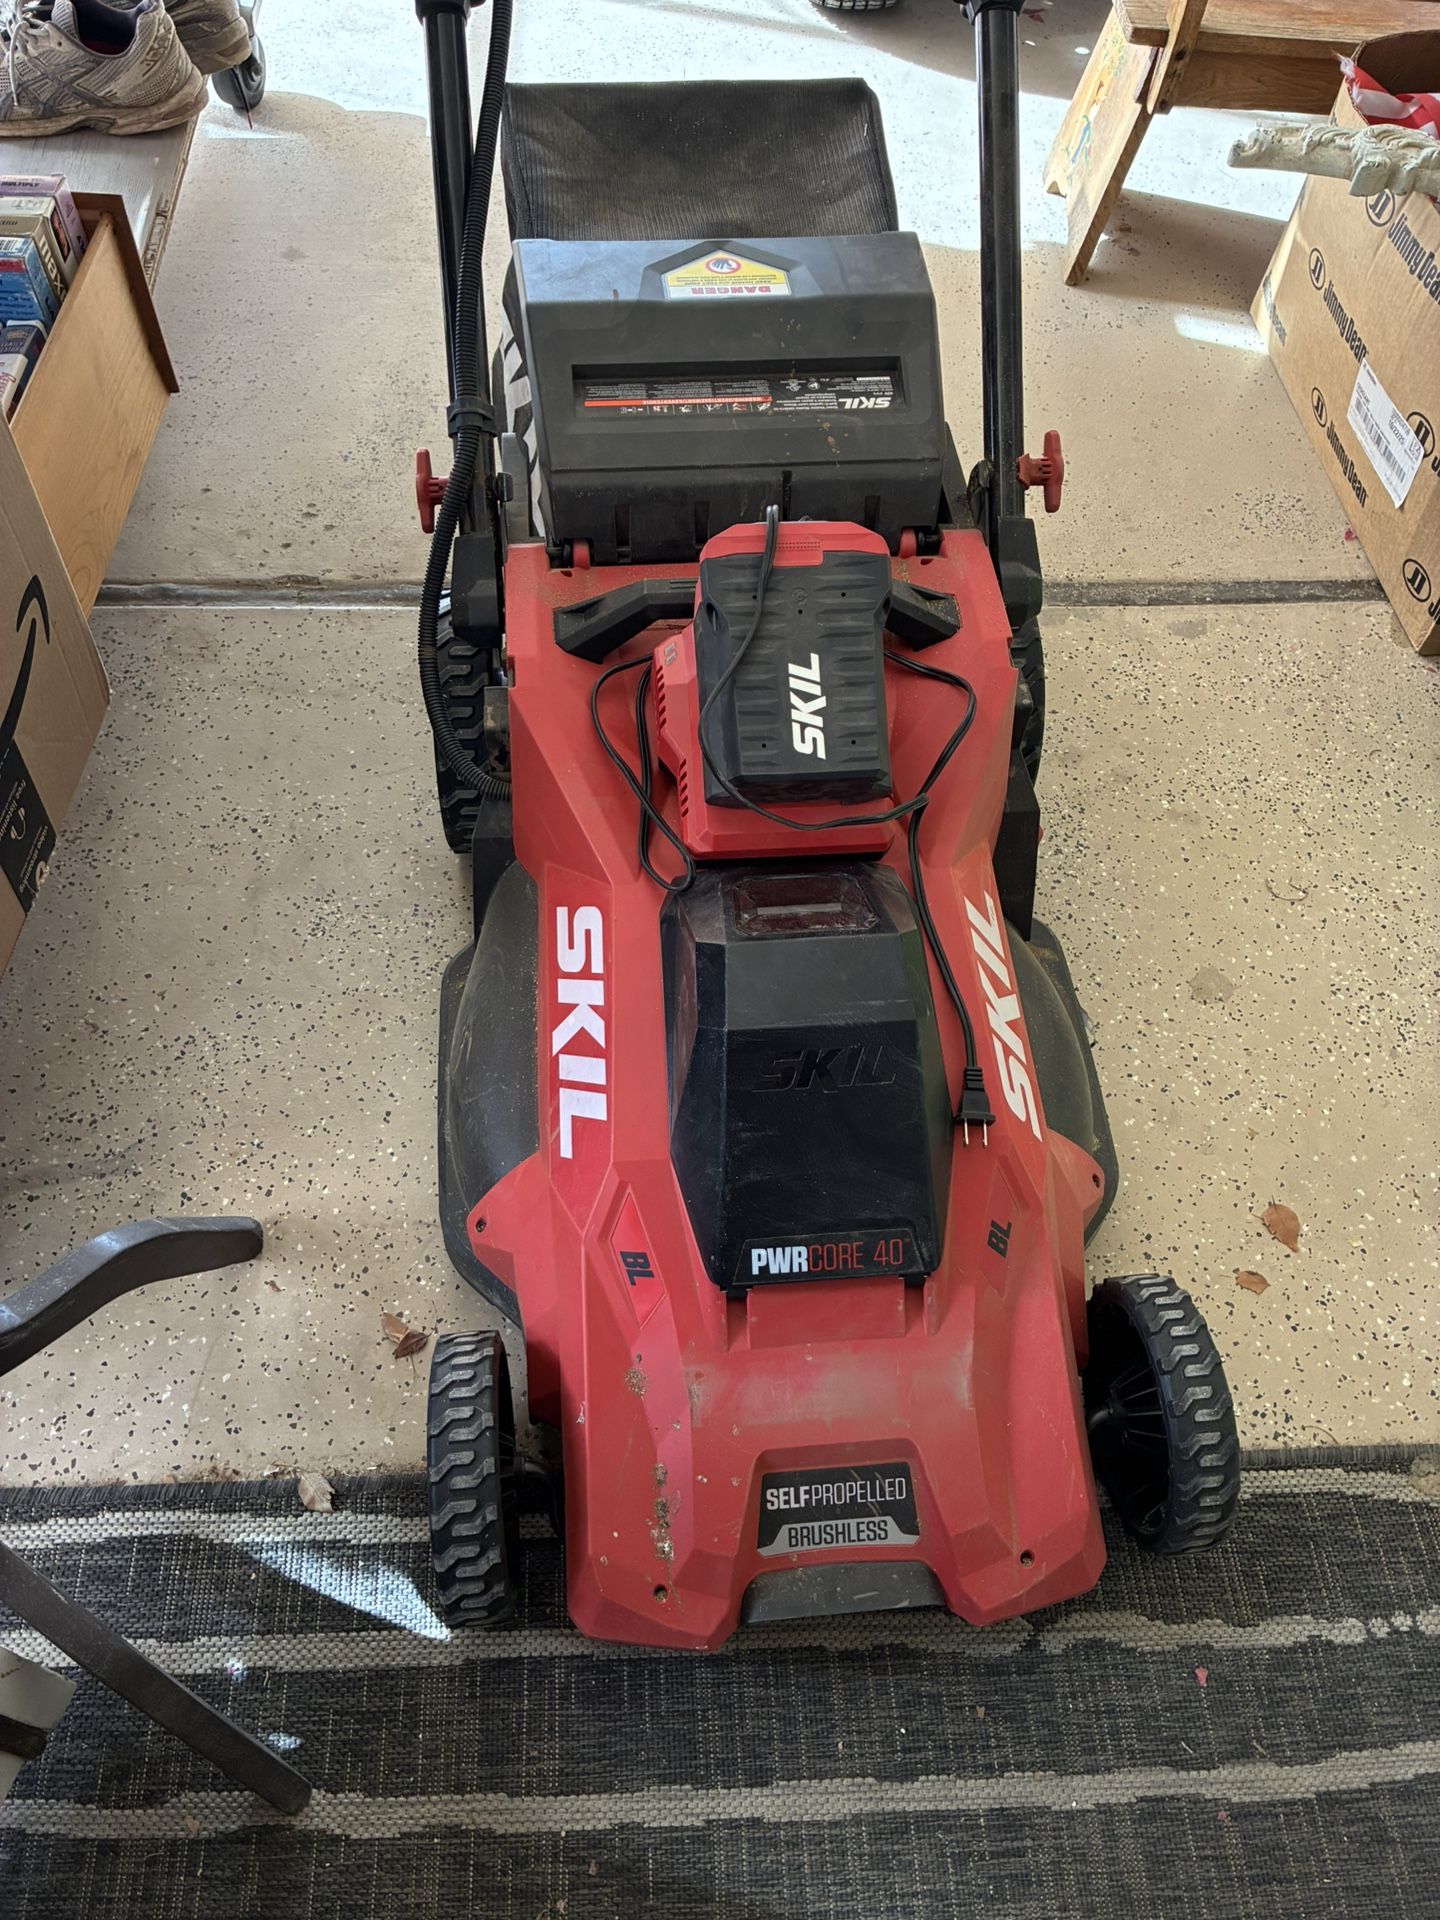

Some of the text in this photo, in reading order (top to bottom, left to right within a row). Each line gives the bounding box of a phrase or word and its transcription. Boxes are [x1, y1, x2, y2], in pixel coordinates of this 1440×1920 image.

[1388, 213, 1440, 306] Jimmy Dea
[691, 285, 771, 295] DANGER
[1323, 279, 1368, 366] Jimmy Dean
[839, 396, 892, 409] SKIL
[1326, 420, 1368, 508] Jimmy Dean
[788, 653, 827, 760] SKIL
[0, 800, 18, 837] listenin
[552, 906, 608, 1159] SKIL
[964, 890, 1043, 1142] SKIL
[752, 1045, 897, 1093] SKIL
[751, 1242, 865, 1275] PWRCORE
[987, 1220, 1012, 1258] BL
[620, 1251, 655, 1286] BL
[788, 1519, 889, 1548] BRUSHLESS
